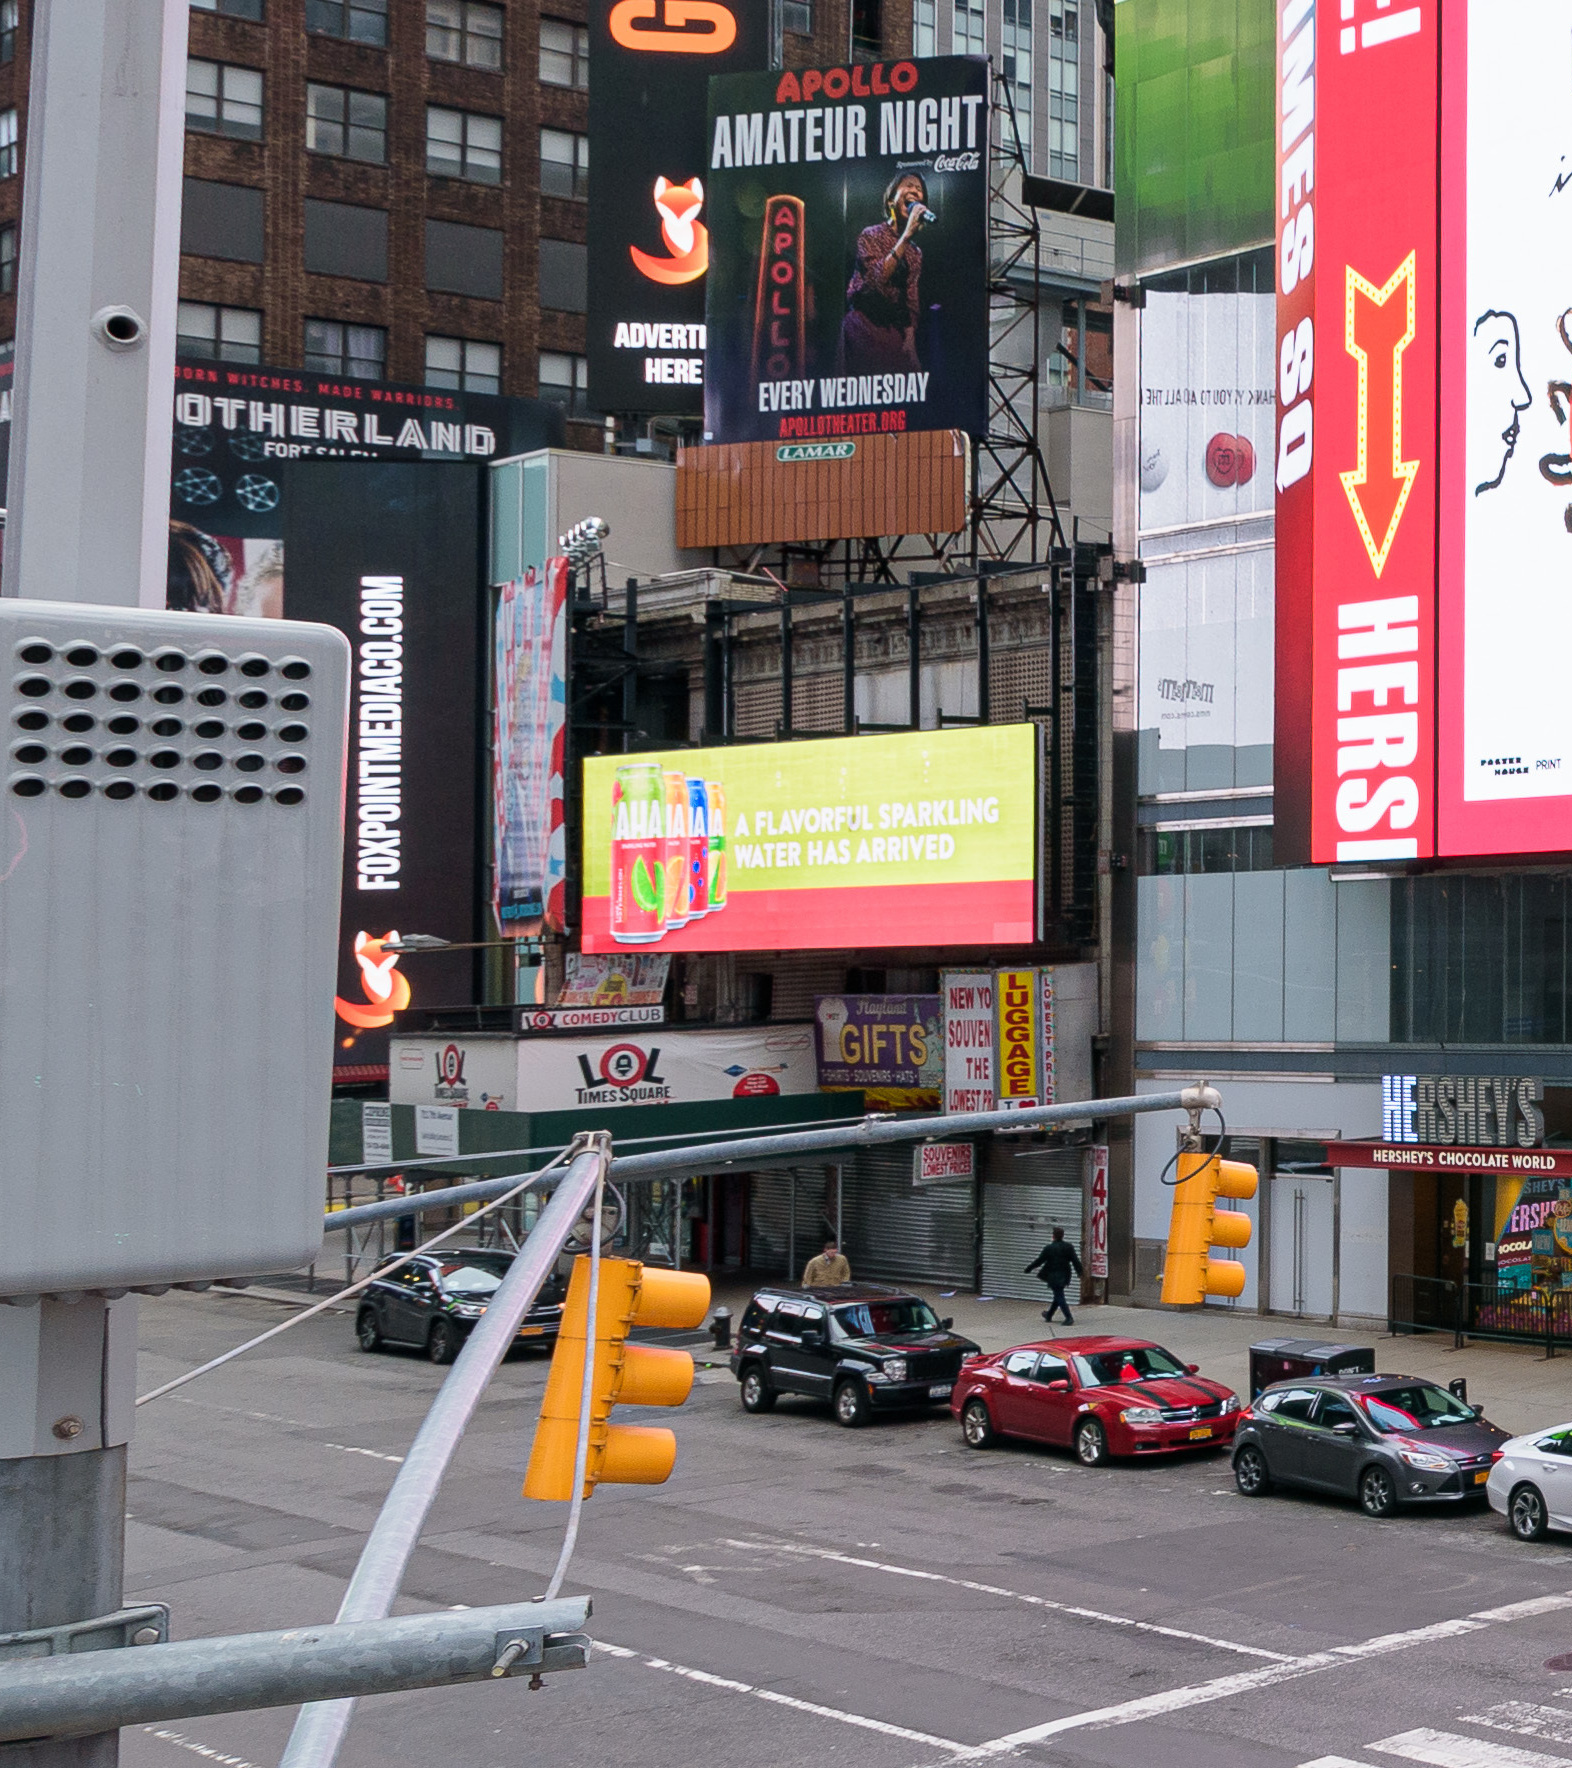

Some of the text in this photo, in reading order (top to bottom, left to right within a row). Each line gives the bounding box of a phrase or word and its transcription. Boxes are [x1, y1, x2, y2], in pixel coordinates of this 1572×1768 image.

[776, 62, 918, 104] APOLLO
[711, 94, 983, 170] AMATEUR NIGHT
[769, 203, 797, 382] APOLLO
[614, 321, 707, 351] ADVERTI
[645, 357, 703, 384] HERE
[318, 383, 363, 401] MADE
[371, 386, 460, 412] WARRIORS.
[758, 370, 931, 413] EVERY WEDNESDAY
[1275, 317, 1314, 494] SQ
[176, 392, 496, 456] OTHERLAND
[779, 409, 907, 438] APOLLOTHEATER.ORG
[264, 440, 312, 460] FORT
[783, 443, 849, 460] LAMAR
[357, 574, 404, 891] FOXPOINTMEDIACO.COM
[615, 799, 664, 840] AHA
[734, 796, 1000, 838] A FLAVORFUL SPARKLING
[733, 832, 956, 869] WATER HAS ARRIVED
[562, 1005, 663, 1026] COMEDYCLUB
[949, 986, 992, 1010] NEW YO
[1042, 977, 1054, 1047] LOWEST
[839, 1024, 928, 1066] GIFTS
[948, 1019, 993, 1048] SOUVENI
[1004, 974, 1032, 1096] LUGGAGE
[576, 1041, 665, 1090] LOL
[966, 1057, 990, 1080] THE
[576, 1084, 672, 1106] TIMES SQUARE
[949, 1090, 981, 1112] LOWEST
[1382, 1074, 1544, 1149] HERSHEY'S
[922, 1143, 972, 1163] SOUVENIRS
[922, 1160, 972, 1178] LOWEST PRICES
[1373, 1149, 1556, 1170] HERSHEY'S CHOCOLATE WORLD
[1091, 1168, 1107, 1206] 4
